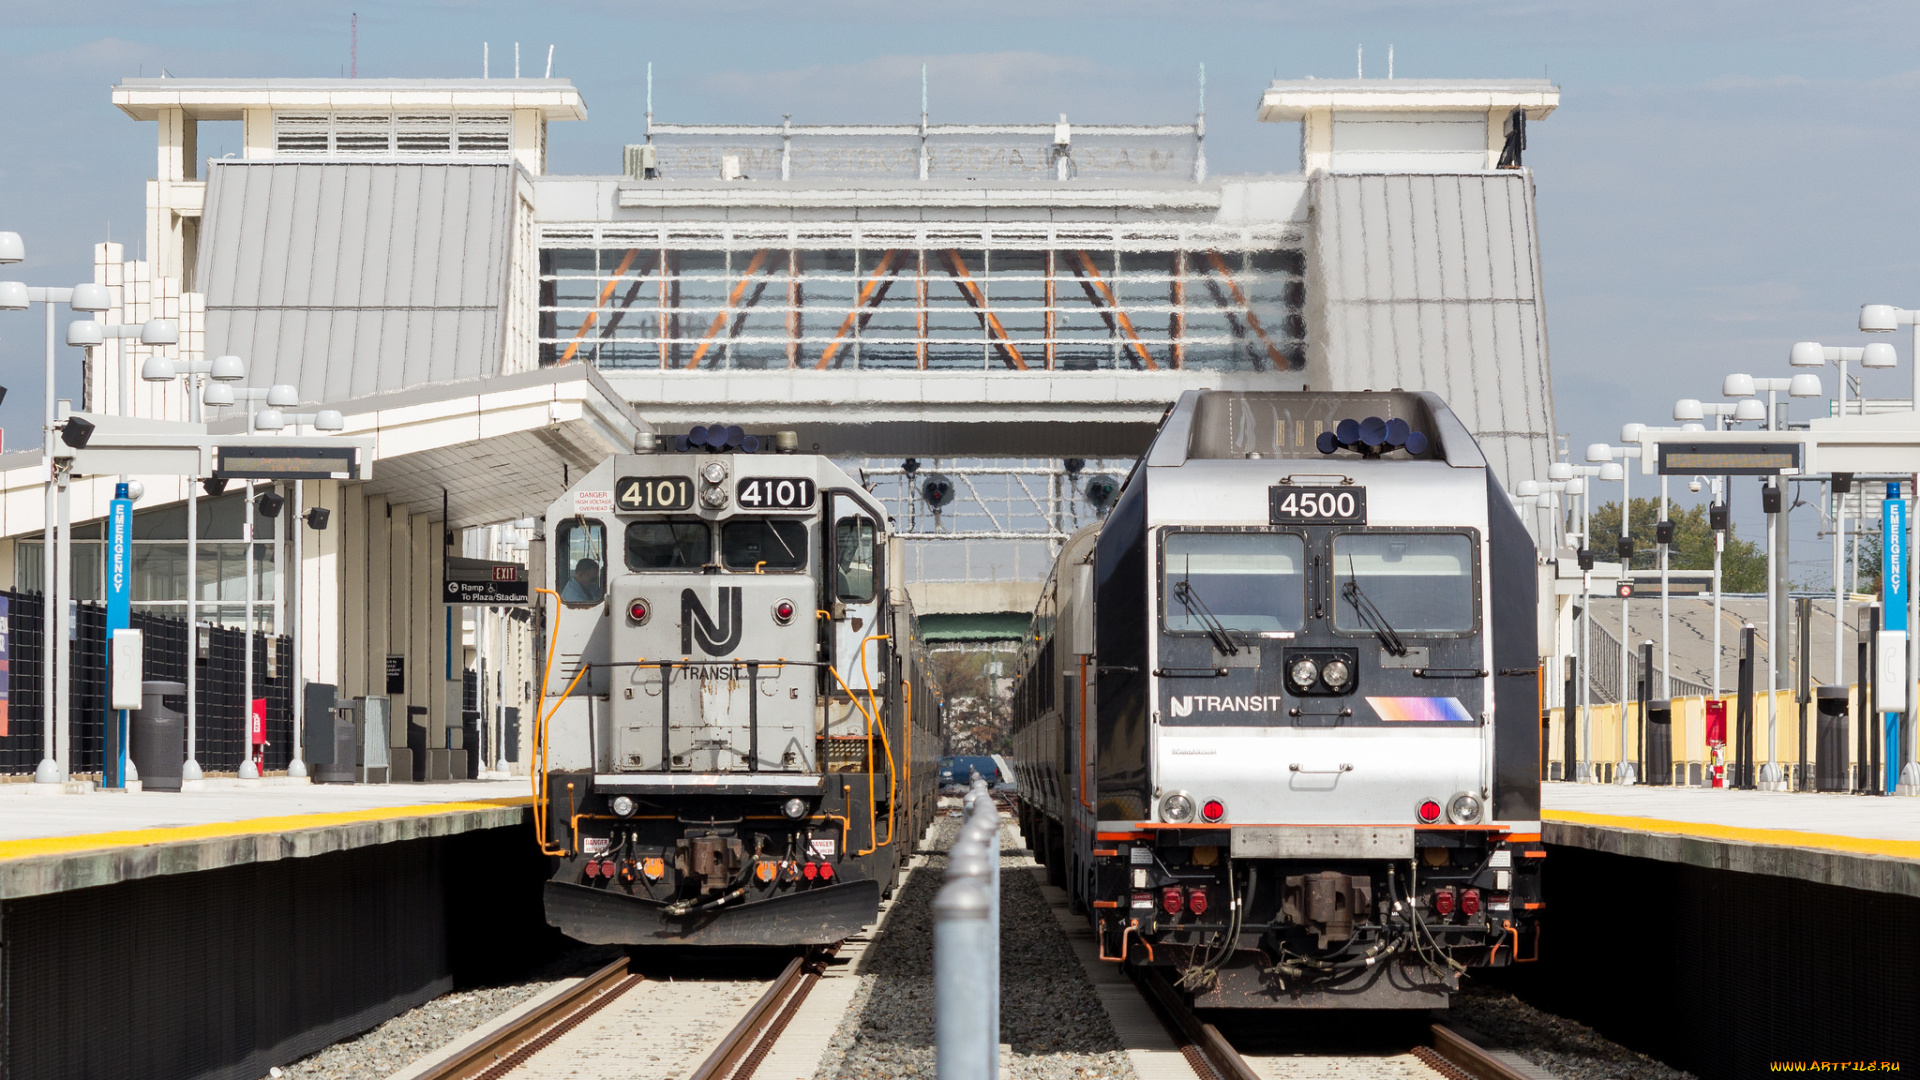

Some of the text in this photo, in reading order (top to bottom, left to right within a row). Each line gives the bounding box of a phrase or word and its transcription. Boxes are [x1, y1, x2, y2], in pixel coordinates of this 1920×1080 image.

[579, 491, 608, 499] DANGER
[621, 480, 686, 507] 4101
[740, 480, 806, 506] 4101
[1280, 492, 1355, 517] 4500
[113, 504, 125, 593] EMERGENCY
[1890, 504, 1900, 595] EMERGENCY
[496, 567, 514, 580] EXIT
[461, 583, 485, 593] Ramp
[461, 593, 528, 602] To Plaza/Stadium
[681, 586, 743, 658] NJ
[682, 666, 742, 681] TRANSIT
[1170, 696, 1281, 718] NJ TRANSIT
